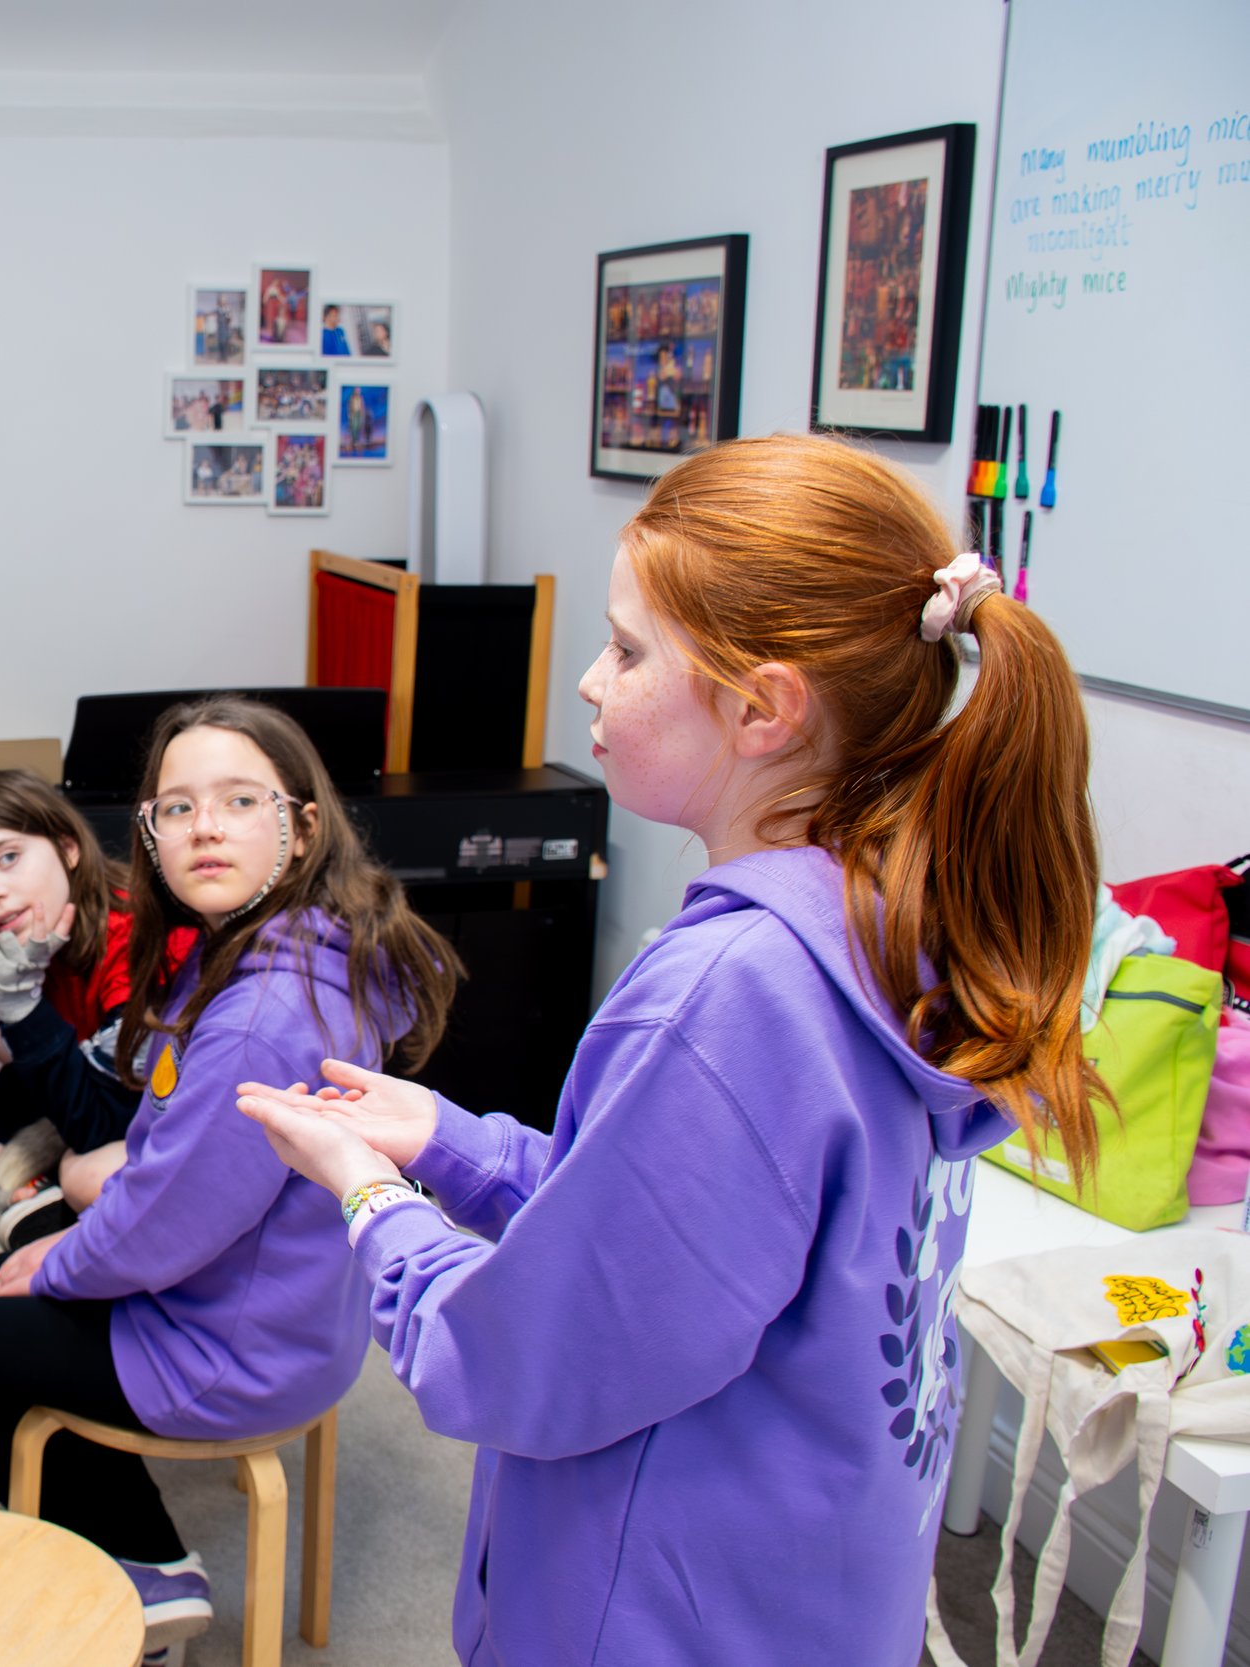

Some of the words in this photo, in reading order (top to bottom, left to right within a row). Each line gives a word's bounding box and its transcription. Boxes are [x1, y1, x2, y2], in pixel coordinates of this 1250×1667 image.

[1087, 120, 1191, 167] mumbling
[1207, 109, 1250, 143] mic
[1010, 196, 1041, 225] are
[1052, 183, 1121, 228] making
[1136, 168, 1201, 210] merry
[1005, 268, 1067, 314] Mighty
[1082, 270, 1127, 293] mice
